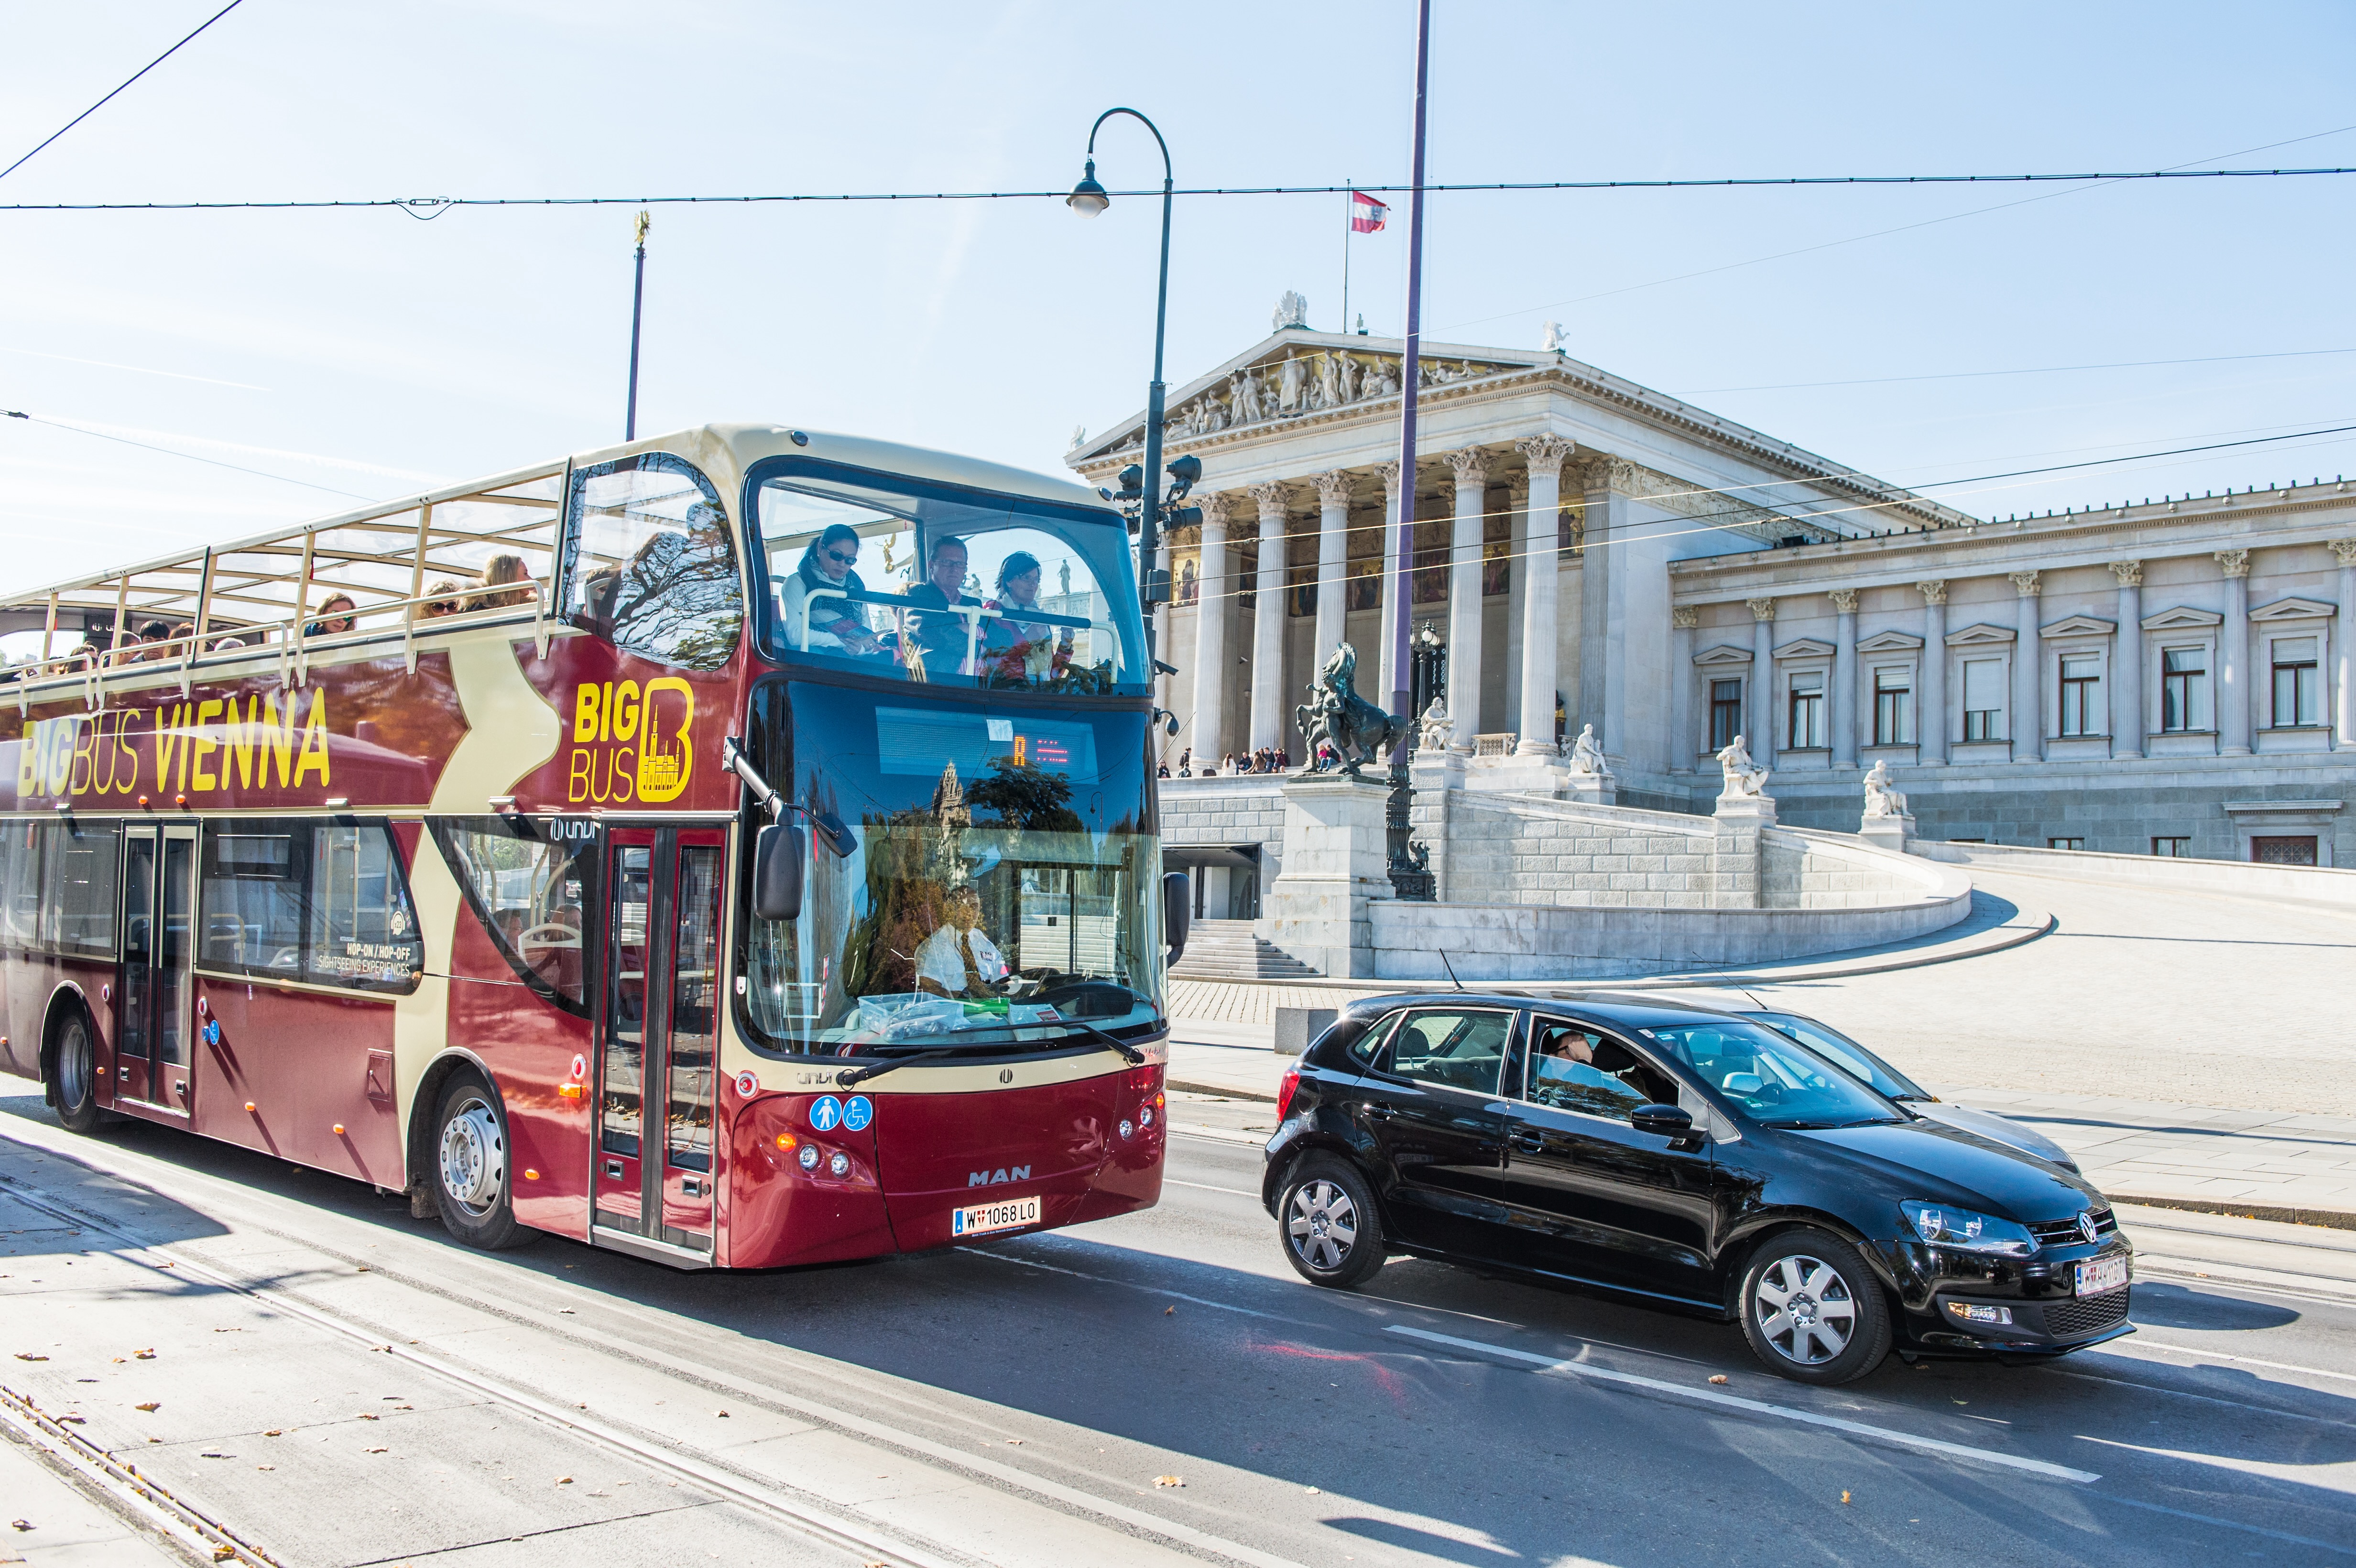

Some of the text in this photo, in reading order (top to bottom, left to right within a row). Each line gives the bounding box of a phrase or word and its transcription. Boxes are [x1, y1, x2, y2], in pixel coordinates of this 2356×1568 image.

[574, 679, 640, 743] BIG
[155, 686, 330, 794] VIENNA
[568, 747, 634, 803] BUS
[347, 942, 373, 958] HOP-ON
[380, 945, 411, 960] HOP-OFF
[318, 955, 410, 977] SIGHTSEEING EXPERIENCES
[968, 1165, 1031, 1187] MAN
[967, 1202, 1035, 1229] W 1068 LO
[2083, 1268, 2091, 1290] W
